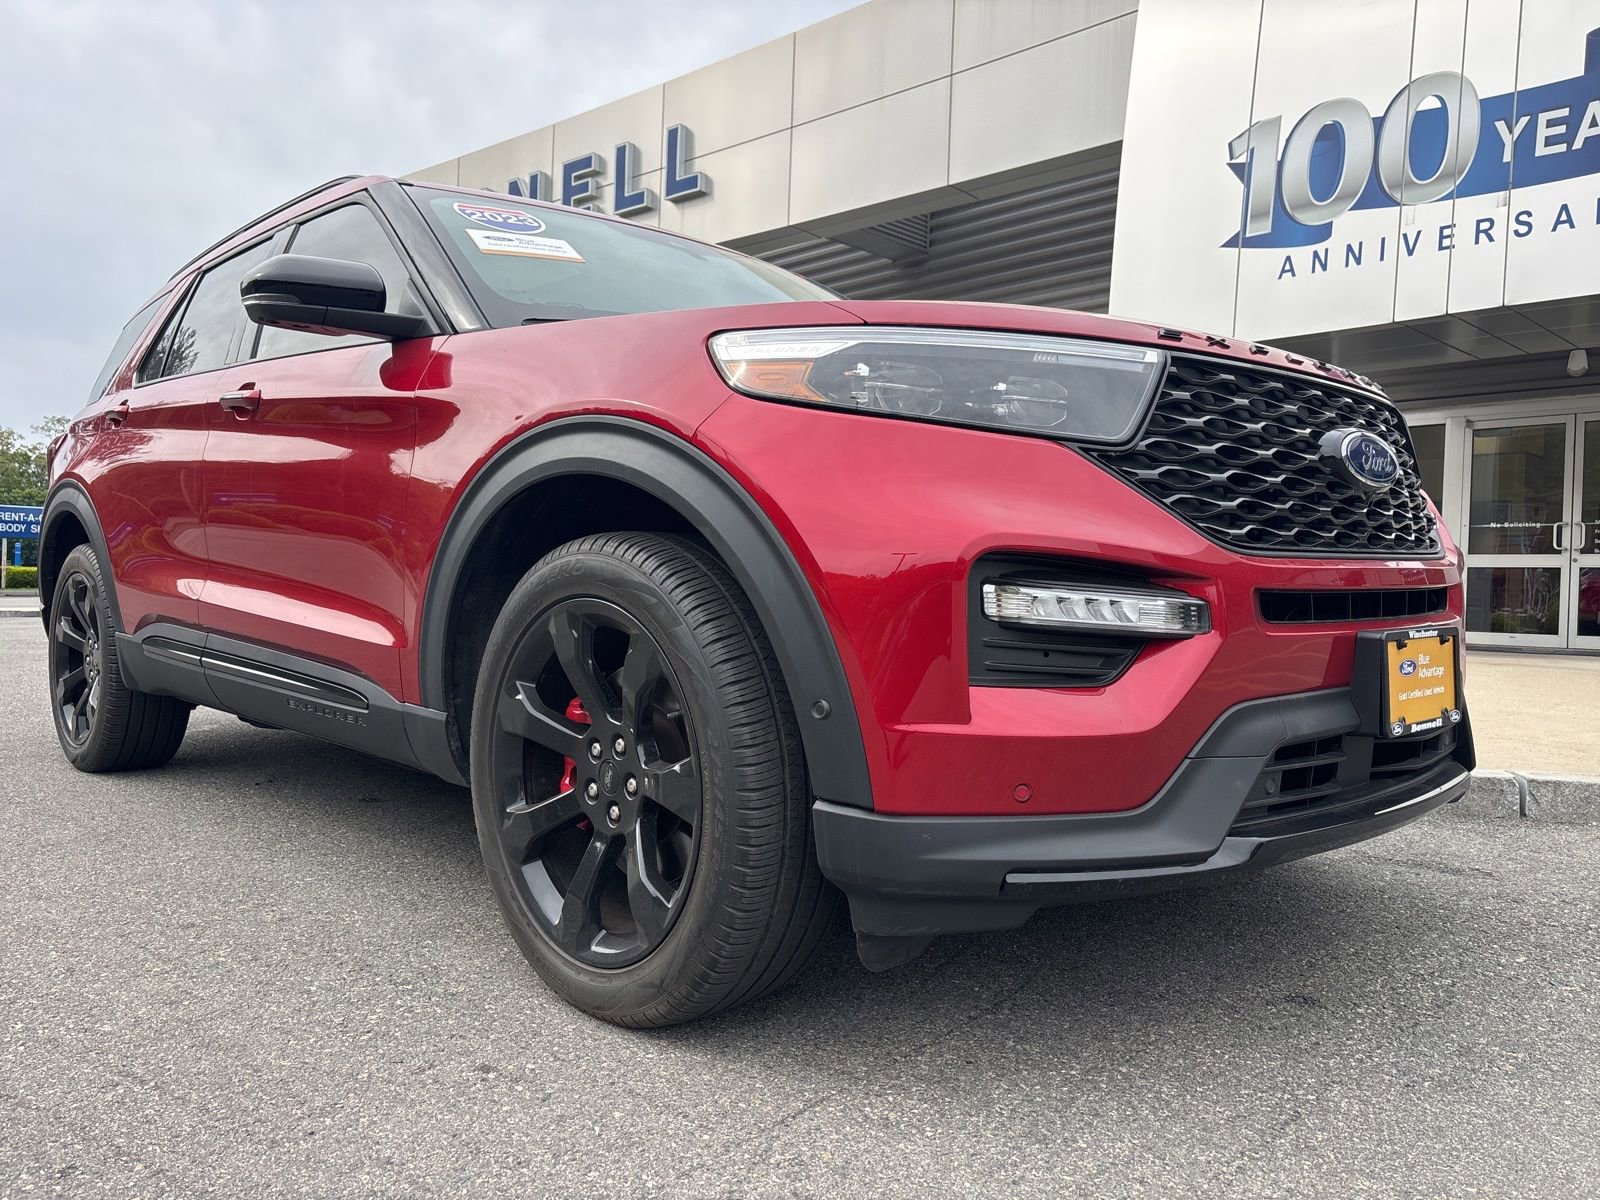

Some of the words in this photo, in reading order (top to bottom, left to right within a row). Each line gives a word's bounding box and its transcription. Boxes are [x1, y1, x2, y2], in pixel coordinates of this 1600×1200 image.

[1229, 71, 1481, 237] 100
[464, 208, 540, 227] 2023
[1277, 197, 1600, 280] ANNIVERSA
[1361, 441, 1395, 473] Ford
[30, 524, 41, 534] S
[1503, 521, 1541, 529] Soliciting
[1409, 629, 1439, 639] Winchester
[1418, 652, 1430, 666] Blue
[1418, 665, 1445, 679] Advantage
[1398, 690, 1408, 700] Gold
[287, 699, 367, 728] EXPLORER
[1410, 718, 1443, 733] Bonnell
